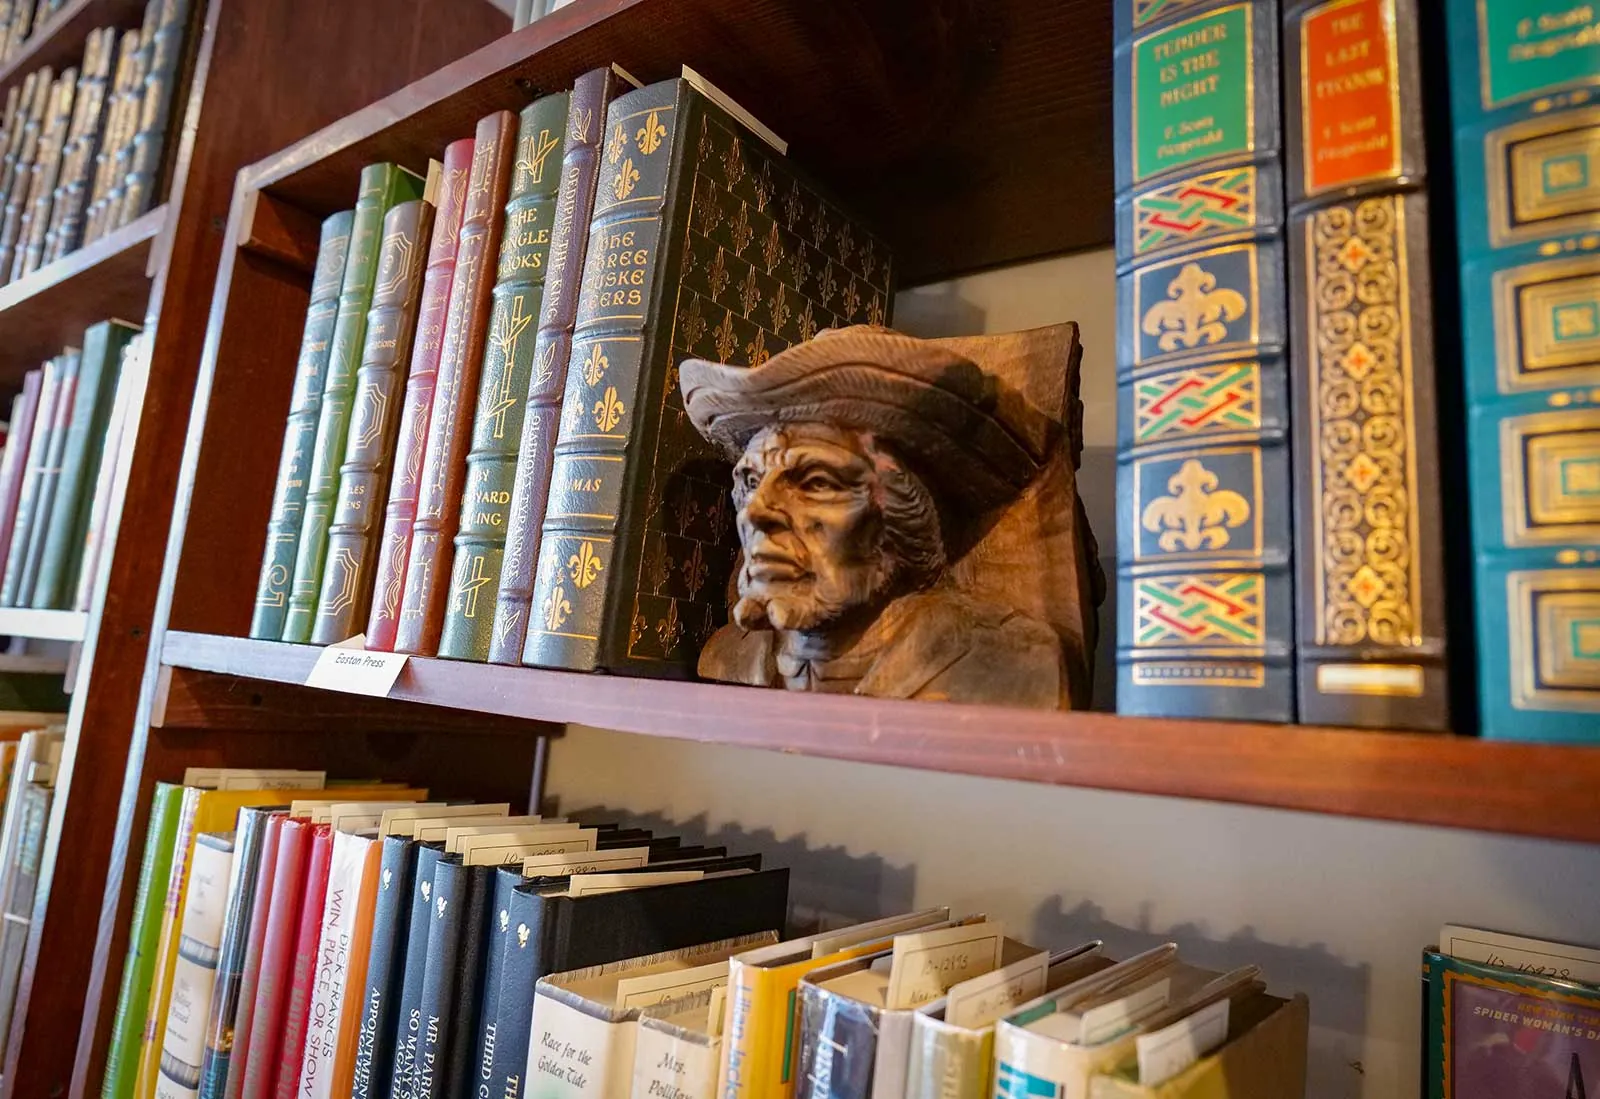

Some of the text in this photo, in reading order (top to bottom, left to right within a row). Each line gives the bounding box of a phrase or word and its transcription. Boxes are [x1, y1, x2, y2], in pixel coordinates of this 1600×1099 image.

[1154, 23, 1228, 62] TENDER
[1160, 49, 1220, 83] IS THE
[1160, 74, 1220, 107] NIGHT
[547, 167, 580, 320] OEDIPUS THE KING
[363, 655, 385, 668] Press
[303, 889, 344, 1098] WIN, PLACE, OR SHOW
[322, 934, 348, 1058] DICK FRANCIS
[408, 1008, 421, 1031] SO
[426, 1015, 440, 1046] MR.
[1473, 1006, 1518, 1024] SPIDER
[1522, 1015, 1583, 1037] WOMAN'S
[402, 1034, 417, 1086] MANY
[481, 1022, 497, 1080] THIRD
[540, 1031, 592, 1066] Race for the
[657, 1052, 685, 1075] Mrs.
[538, 1055, 587, 1089] Golden Tide
